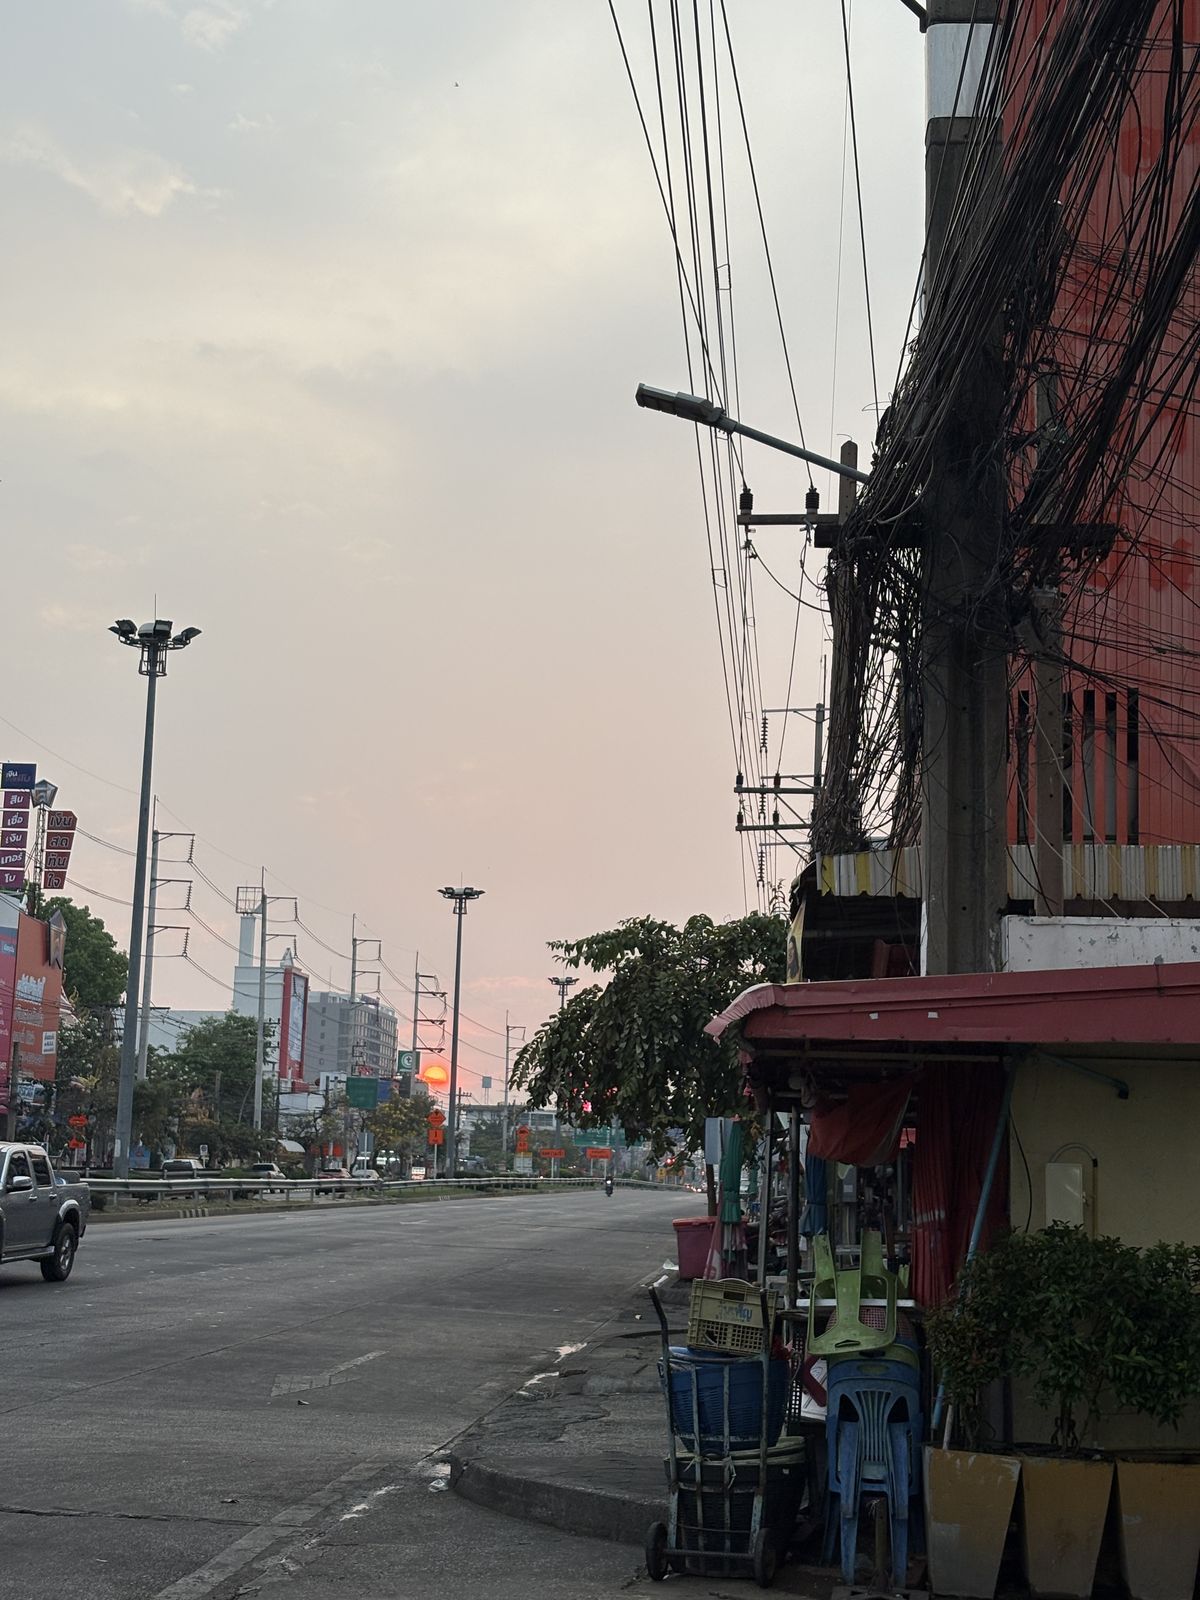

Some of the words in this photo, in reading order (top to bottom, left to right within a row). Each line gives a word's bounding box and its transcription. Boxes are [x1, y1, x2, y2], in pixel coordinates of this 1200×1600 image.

[49, 812, 73, 827] เงิน
[50, 836, 69, 847] สด
[47, 872, 61, 887] ใจ
